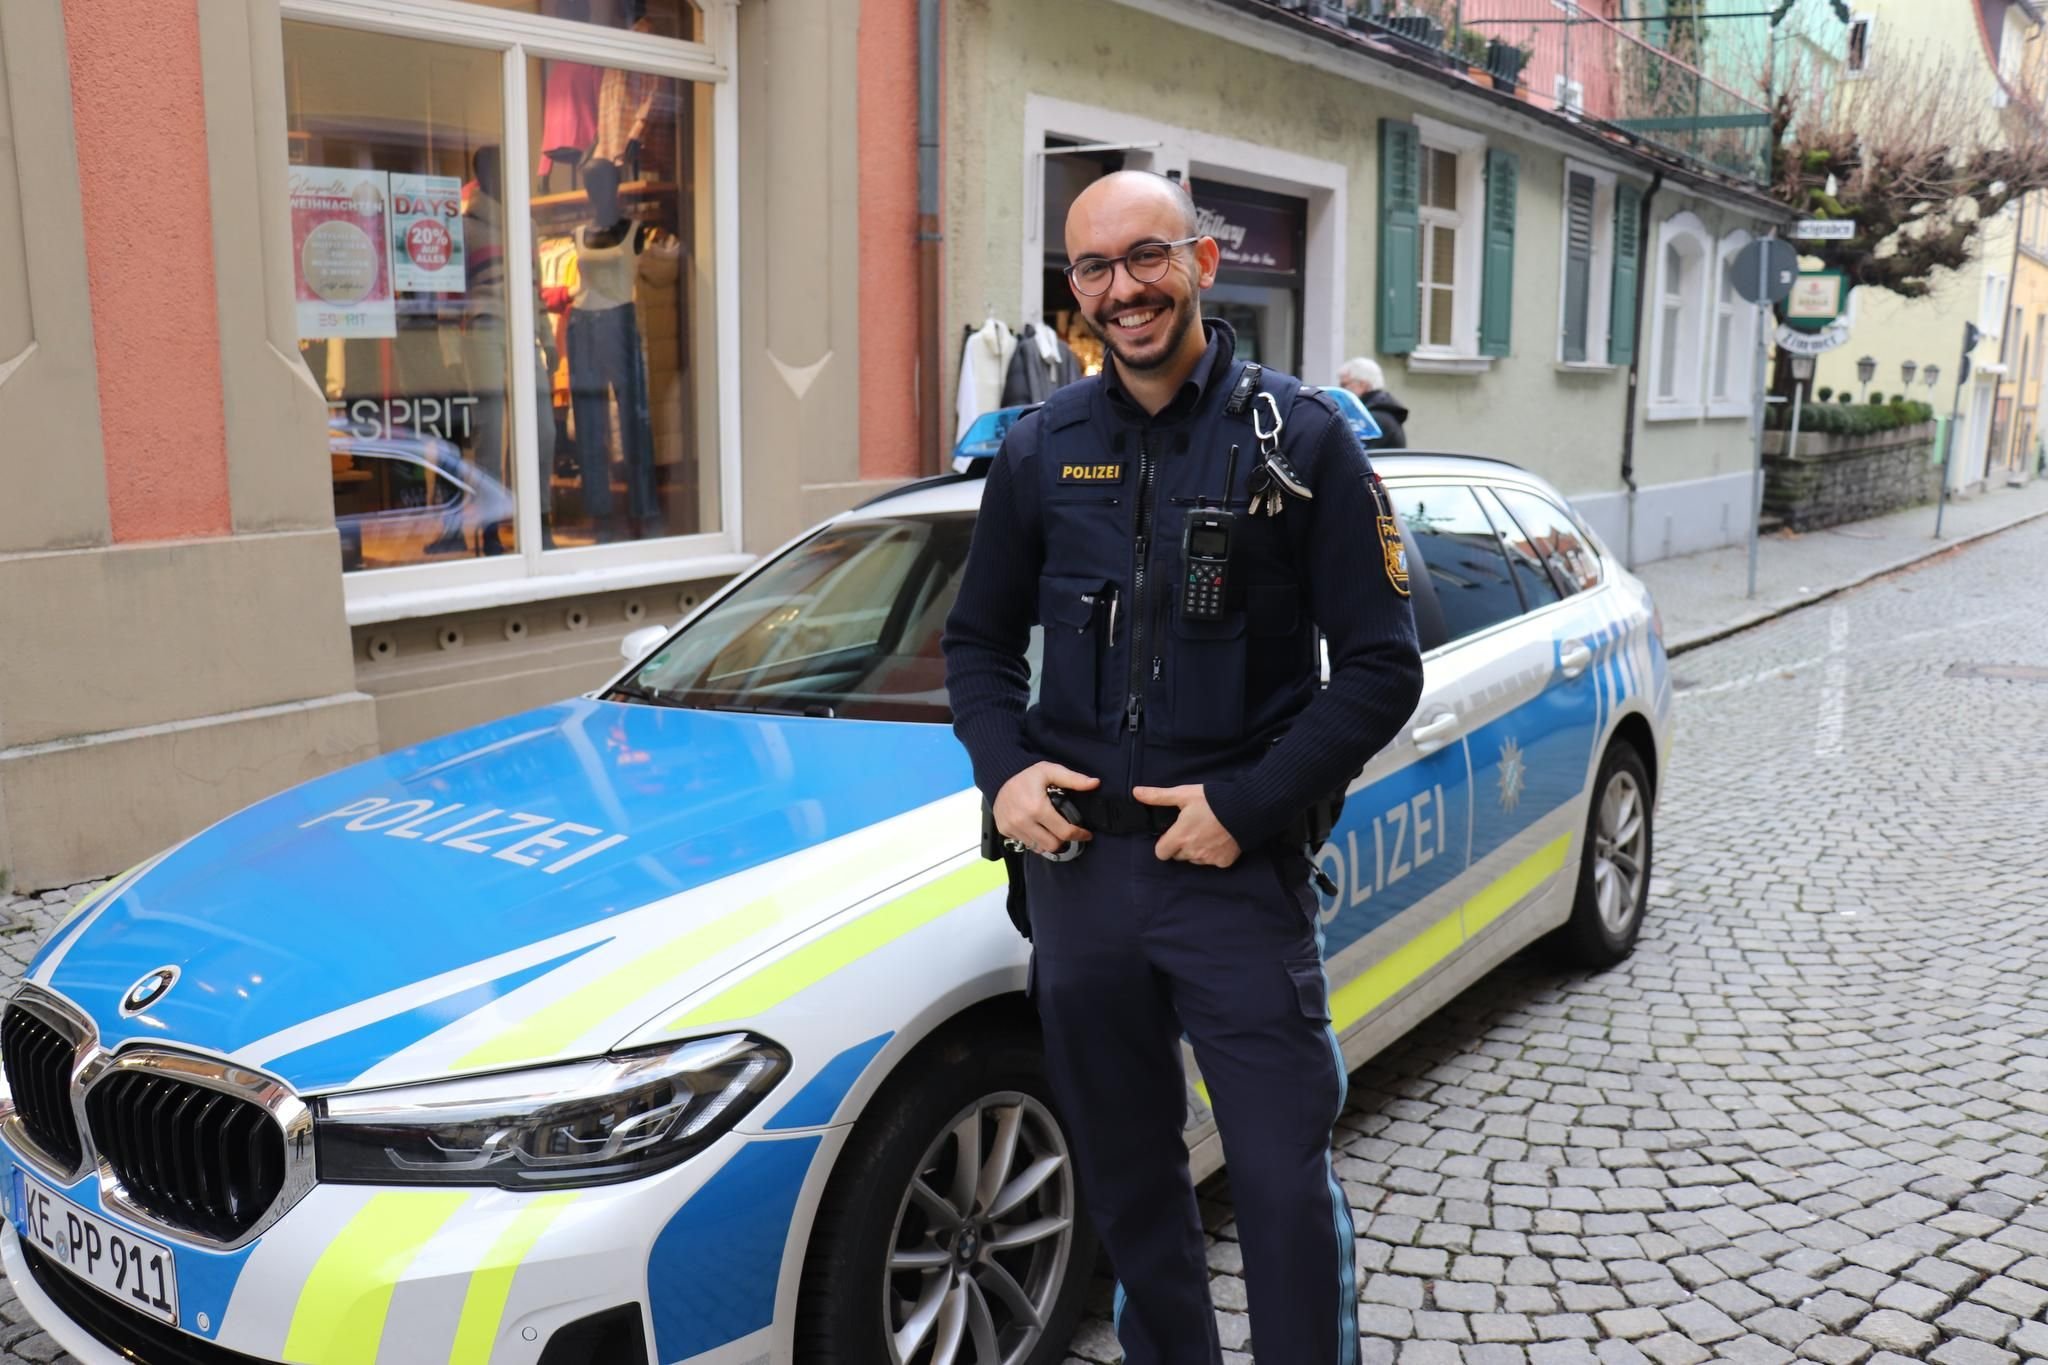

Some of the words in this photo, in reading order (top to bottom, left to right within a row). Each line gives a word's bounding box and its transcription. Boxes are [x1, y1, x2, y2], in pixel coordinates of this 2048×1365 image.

[290, 197, 383, 214] WEIHNACHTEN
[395, 194, 459, 218] DAYS
[412, 227, 448, 246] 20%
[416, 253, 446, 264] ALLES
[421, 246, 439, 254] AUF
[1062, 464, 1120, 480] POLIZEI
[298, 797, 629, 874] POLIZEI
[1305, 783, 1445, 925] OLIZEI
[26, 1182, 55, 1250] KE
[67, 1211, 101, 1275] PP
[110, 1234, 173, 1313] 911
